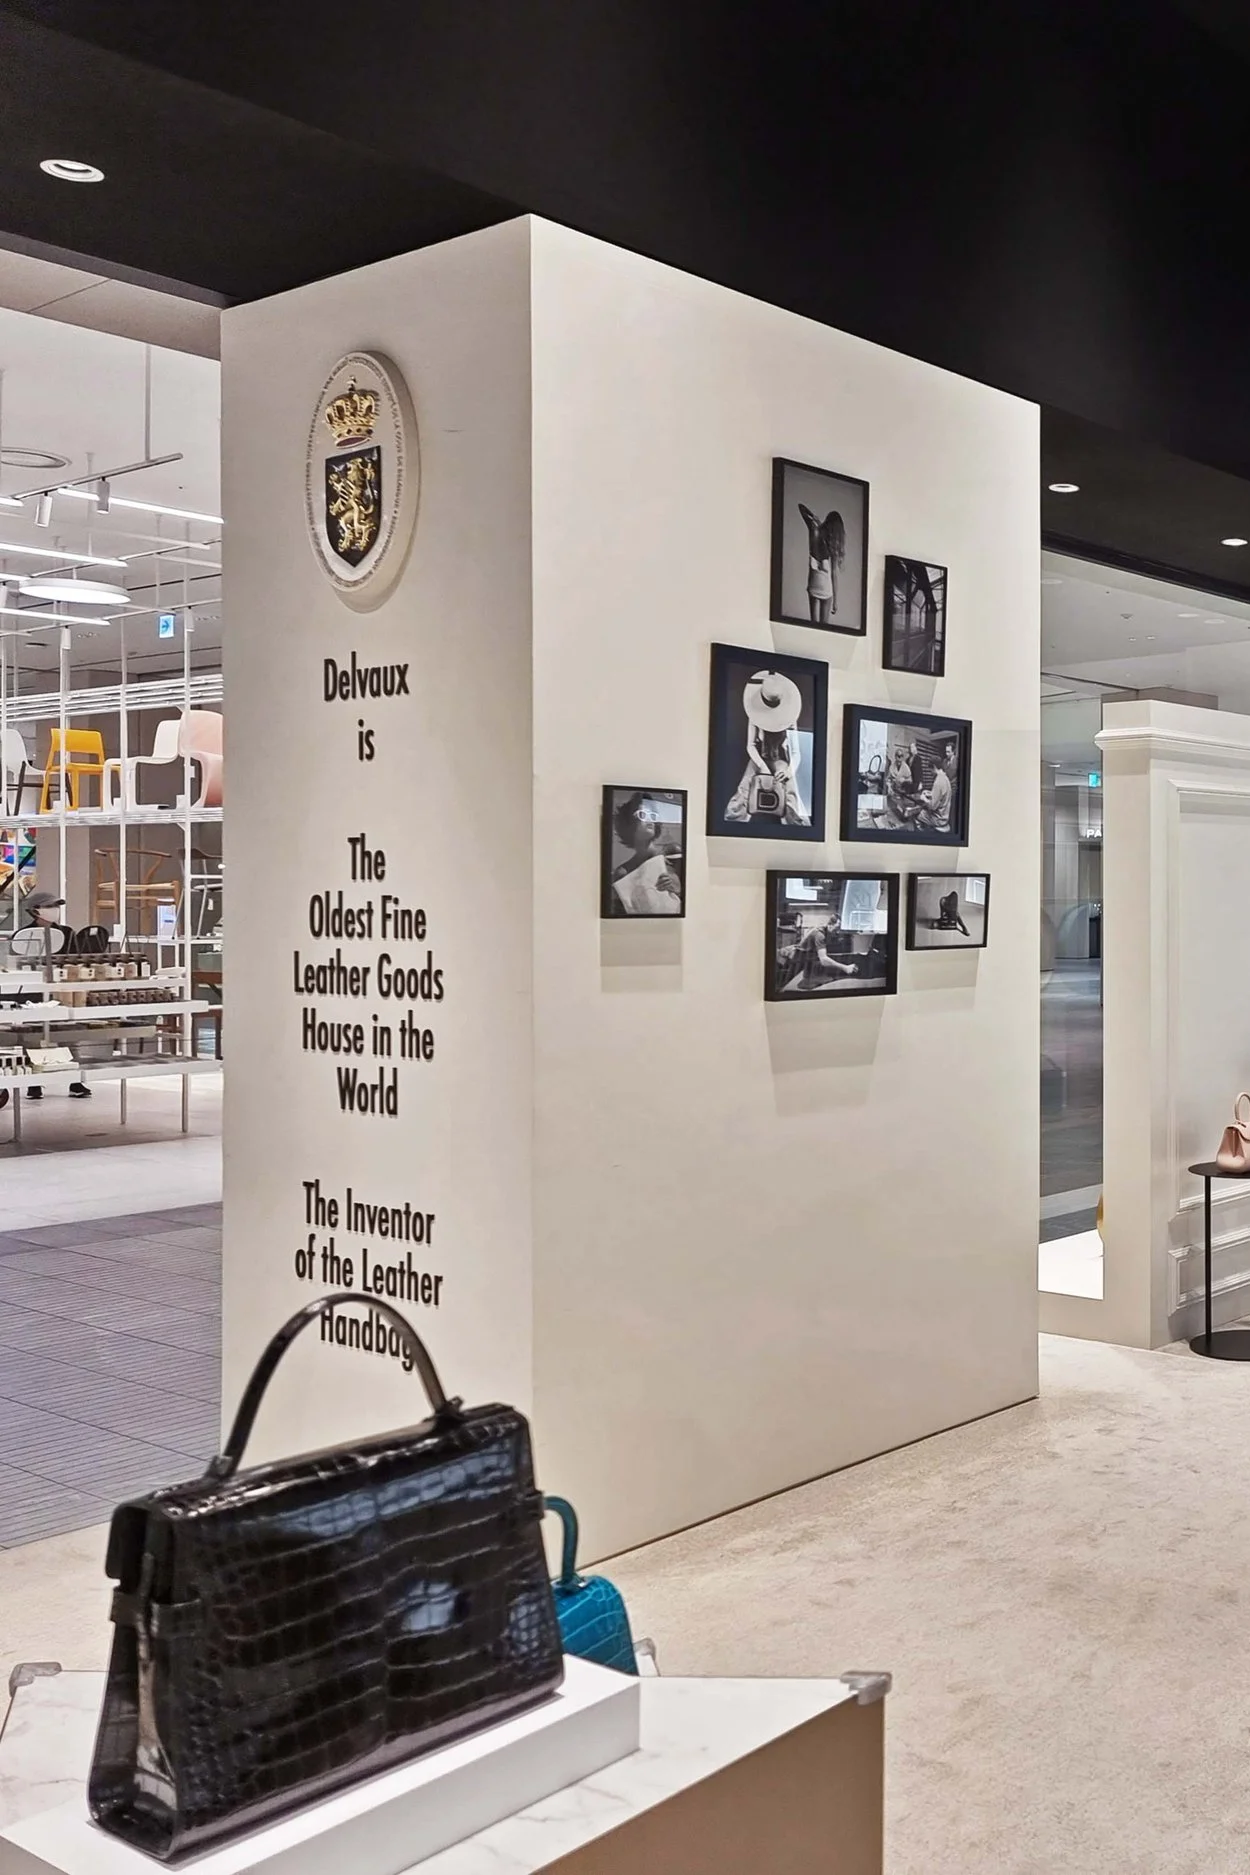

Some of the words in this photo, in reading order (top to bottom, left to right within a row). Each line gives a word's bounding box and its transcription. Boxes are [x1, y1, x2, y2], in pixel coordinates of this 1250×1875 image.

[323, 650, 410, 702] Delvaux
[357, 718, 375, 761] is
[347, 832, 386, 881] The
[309, 890, 374, 939] Oldest
[381, 894, 427, 940] Fine
[293, 948, 371, 996] Leather
[377, 950, 444, 1001] Goods
[302, 1007, 364, 1055] House
[372, 1013, 392, 1057] in
[399, 1009, 434, 1060] the
[336, 1066, 398, 1116] World
[302, 1178, 339, 1229] The
[346, 1187, 435, 1244] Inventor
[295, 1233, 316, 1280] of
[320, 1236, 354, 1288] the
[362, 1248, 443, 1306] Leather
[321, 1303, 414, 1372] Handbag
